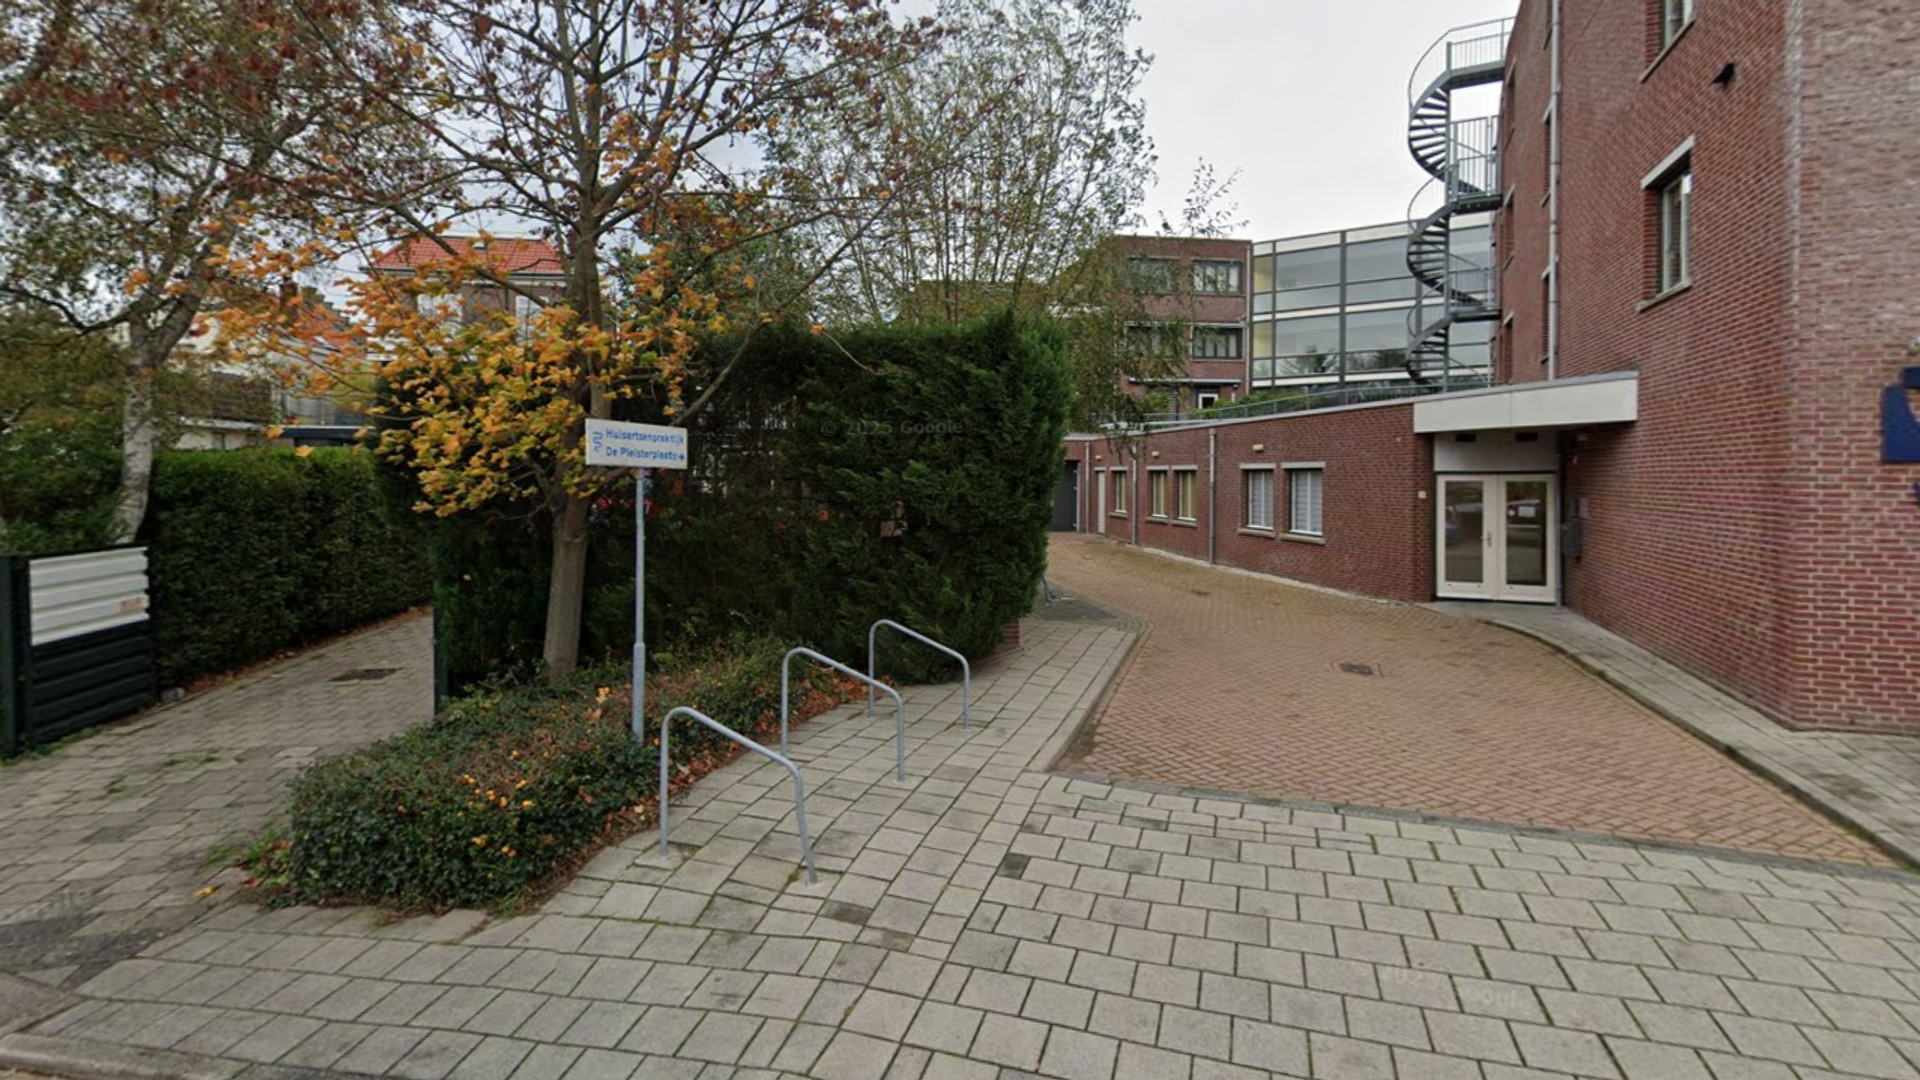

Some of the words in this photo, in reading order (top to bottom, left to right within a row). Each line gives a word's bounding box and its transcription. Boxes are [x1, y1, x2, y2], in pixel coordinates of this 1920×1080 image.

[606, 428, 684, 446] Huisartsenpraktijk
[606, 446, 618, 457] De
[620, 447, 677, 460] Pleisterplaats
